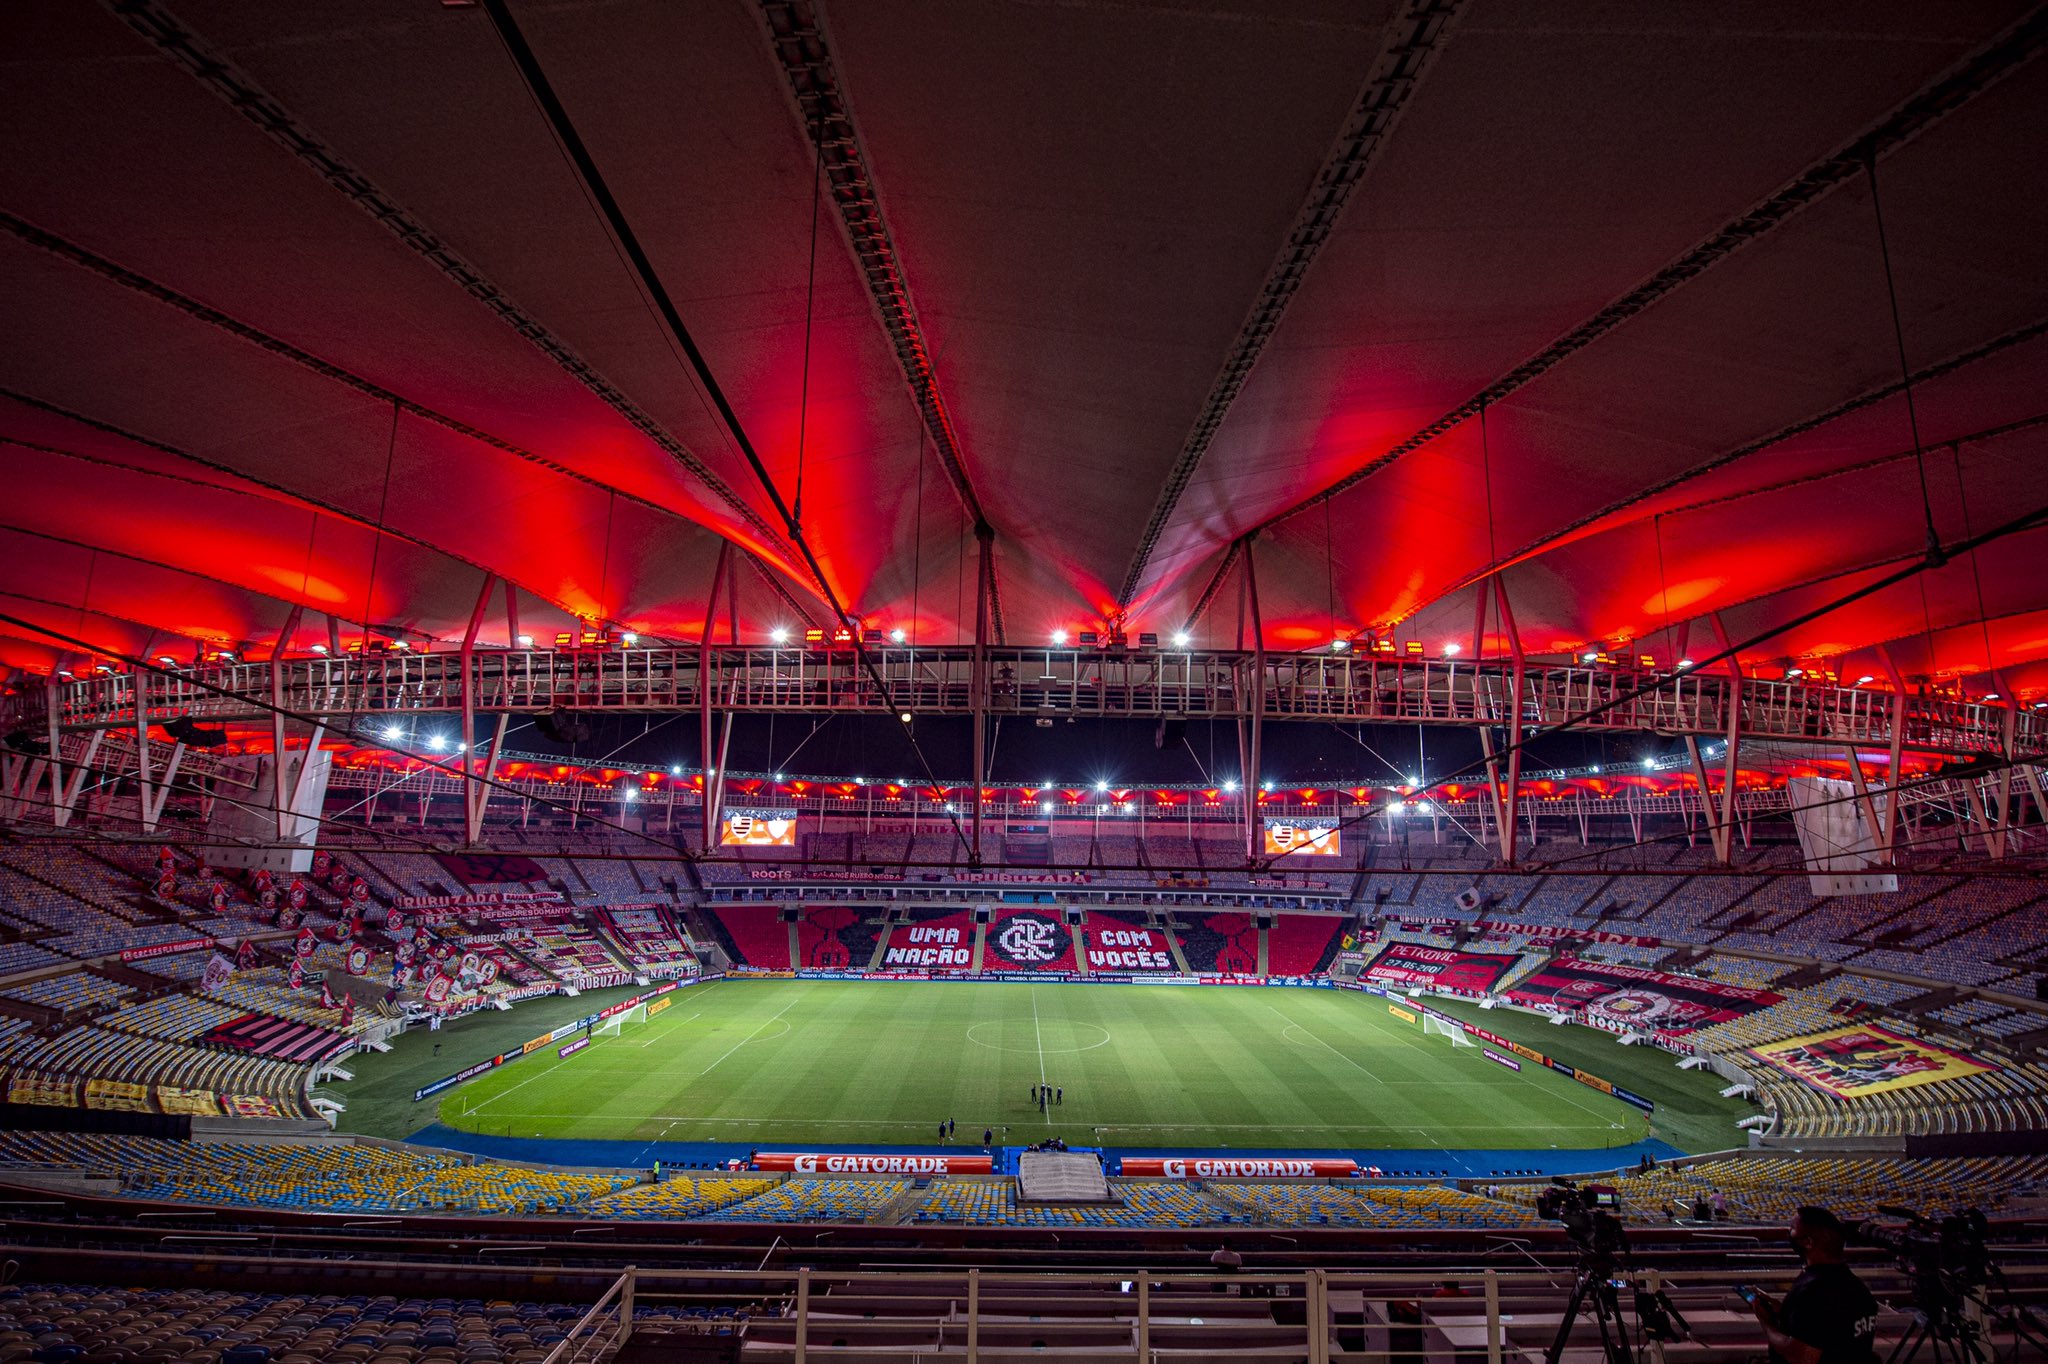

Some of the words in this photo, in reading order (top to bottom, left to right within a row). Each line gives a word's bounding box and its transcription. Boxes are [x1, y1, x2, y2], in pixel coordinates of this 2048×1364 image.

[751, 870, 793, 879] ROOTS
[956, 873, 1088, 884] URUBUZADA
[481, 908, 534, 919] DEFENSORES
[534, 907, 544, 916] DO
[545, 906, 571, 915] MANTO
[1399, 915, 1447, 925] URUBUZADA
[460, 932, 519, 945] URUBUZADA
[909, 927, 960, 943] UMA
[1100, 930, 1152, 946] COM
[1490, 922, 1639, 947] URUBUZADA
[886, 945, 970, 965] NAÇÃO
[1089, 946, 1171, 968] VOCÊS
[686, 965, 698, 977] 12
[1385, 958, 1441, 974] 27-05-2001
[573, 973, 633, 991] URUBUZADA
[1300, 979, 1313, 987] Ford
[1316, 979, 1329, 987] Ford
[509, 984, 556, 1001] MANGUAÇA
[1587, 1013, 1634, 1035] ROOTS
[561, 1044, 574, 1056] QATAR
[573, 1038, 590, 1049] AIRWAYS
[1652, 1033, 1693, 1056] FALANGE
[1483, 1049, 1498, 1061] QATAR
[1498, 1056, 1519, 1070] AIRWAYS
[457, 1068, 474, 1081] QATAR
[473, 1060, 492, 1074] AIRWAYS
[794, 1155, 818, 1173] G
[826, 1156, 948, 1173] GATORADE
[1163, 1159, 1186, 1178] G
[1195, 1160, 1315, 1177] GATORADE
